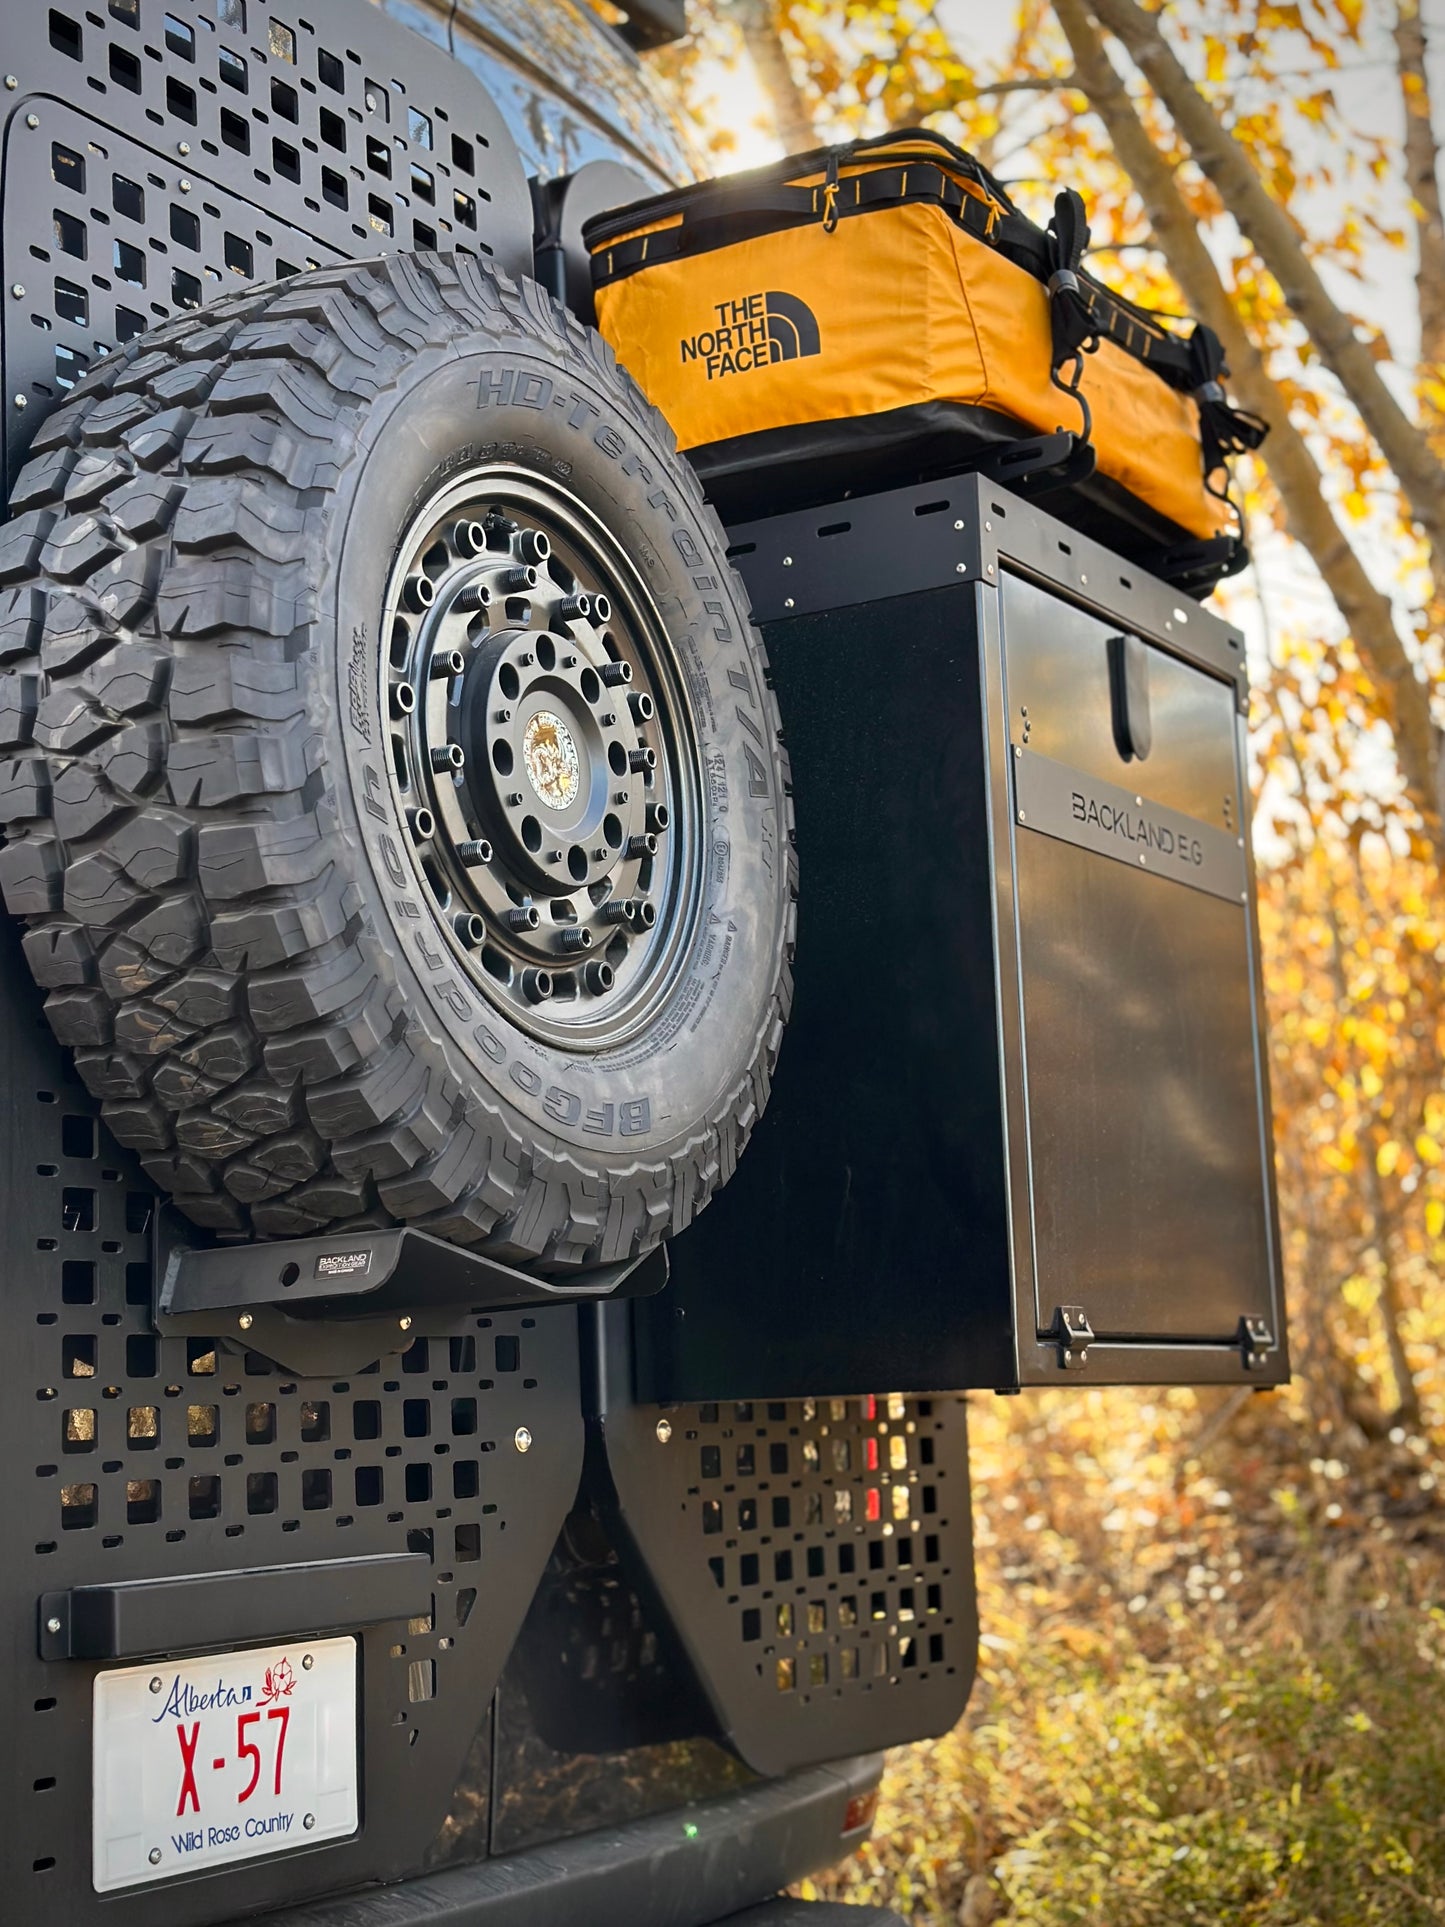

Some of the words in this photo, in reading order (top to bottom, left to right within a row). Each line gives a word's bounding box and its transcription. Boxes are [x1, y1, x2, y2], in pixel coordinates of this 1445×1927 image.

[714, 293, 764, 326] THE
[681, 317, 766, 363] NORTH
[706, 342, 769, 380] FACE
[362, 763, 652, 1137] BFGoodrich
[320, 1253, 367, 1265] BACKLAND
[151, 1674, 244, 1723] Alberta
[176, 1706, 290, 1817] X-57
[171, 1829, 203, 1854] Wild
[208, 1825, 240, 1846] Rose
[245, 1812, 294, 1838] Country
